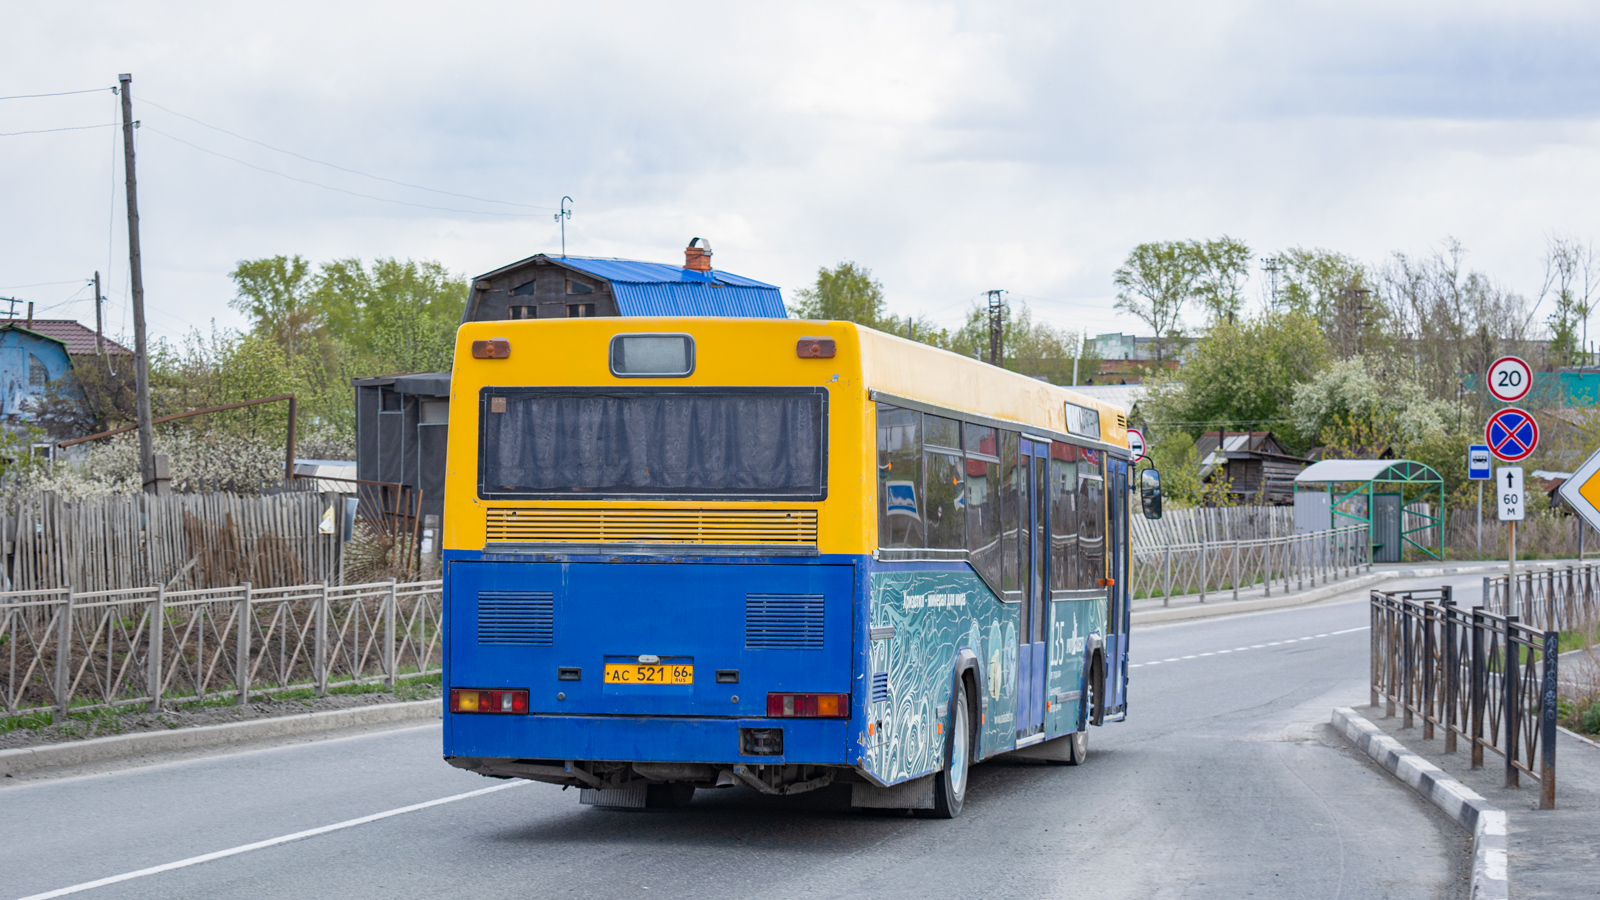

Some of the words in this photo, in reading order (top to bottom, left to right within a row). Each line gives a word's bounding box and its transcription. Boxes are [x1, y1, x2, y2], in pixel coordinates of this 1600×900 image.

[1498, 370, 1522, 387] 20
[1503, 493, 1518, 505] 60
[612, 670, 630, 681] AC
[637, 667, 665, 682] 521
[673, 667, 688, 678] 66
